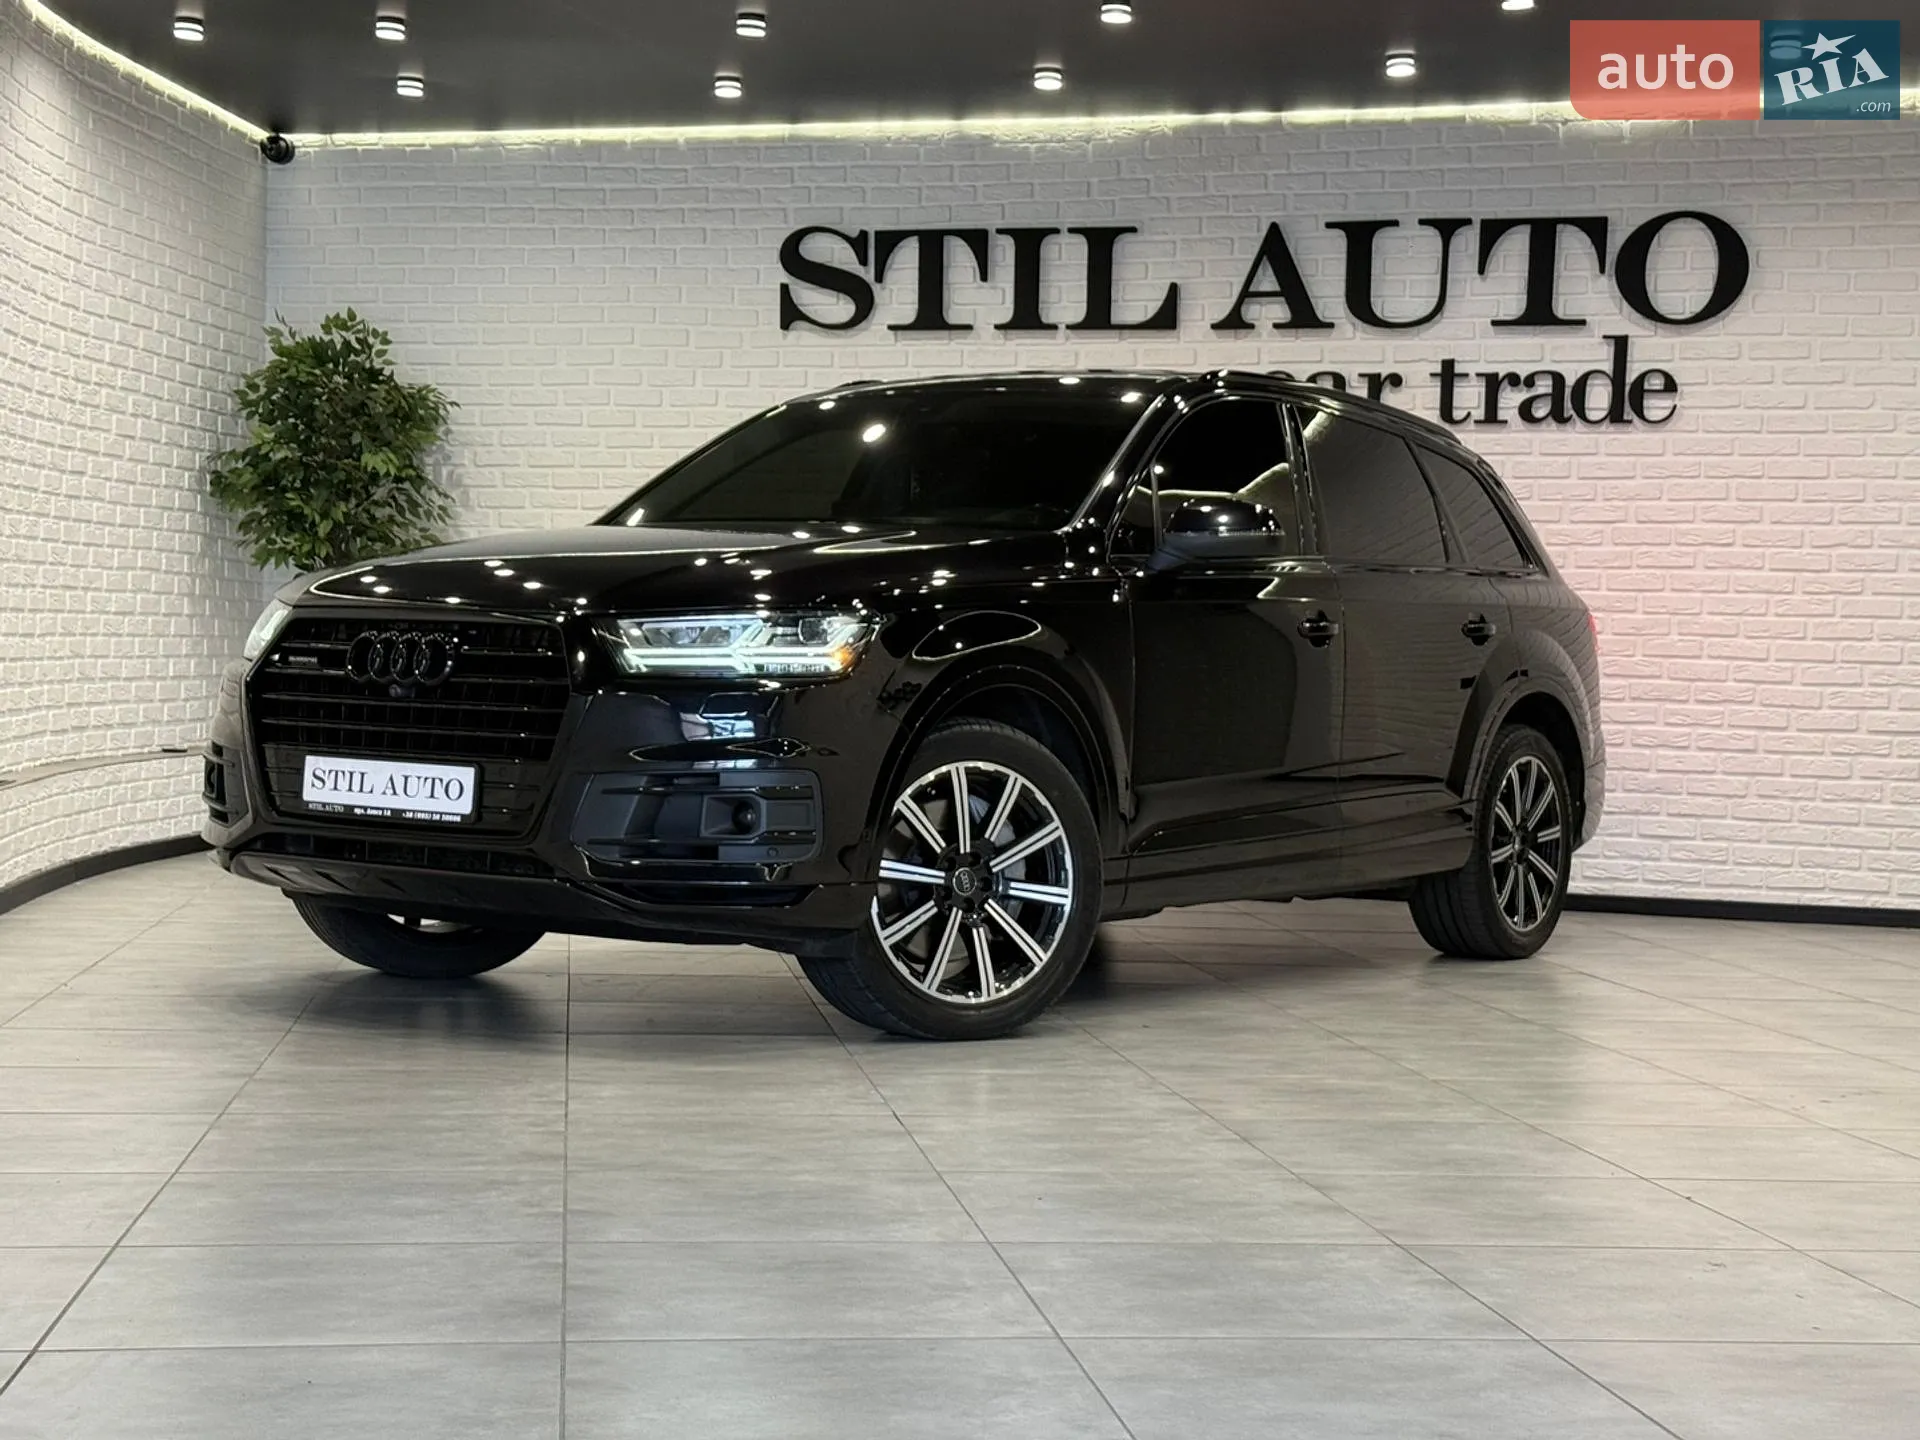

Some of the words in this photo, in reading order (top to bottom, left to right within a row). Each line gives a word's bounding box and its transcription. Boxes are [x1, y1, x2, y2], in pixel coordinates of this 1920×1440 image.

[780, 226, 1178, 331] STIL
[1213, 213, 1750, 328] AUTO
[1430, 335, 1677, 424] trade
[310, 767, 375, 795] STIL
[382, 773, 465, 801] AUTO
